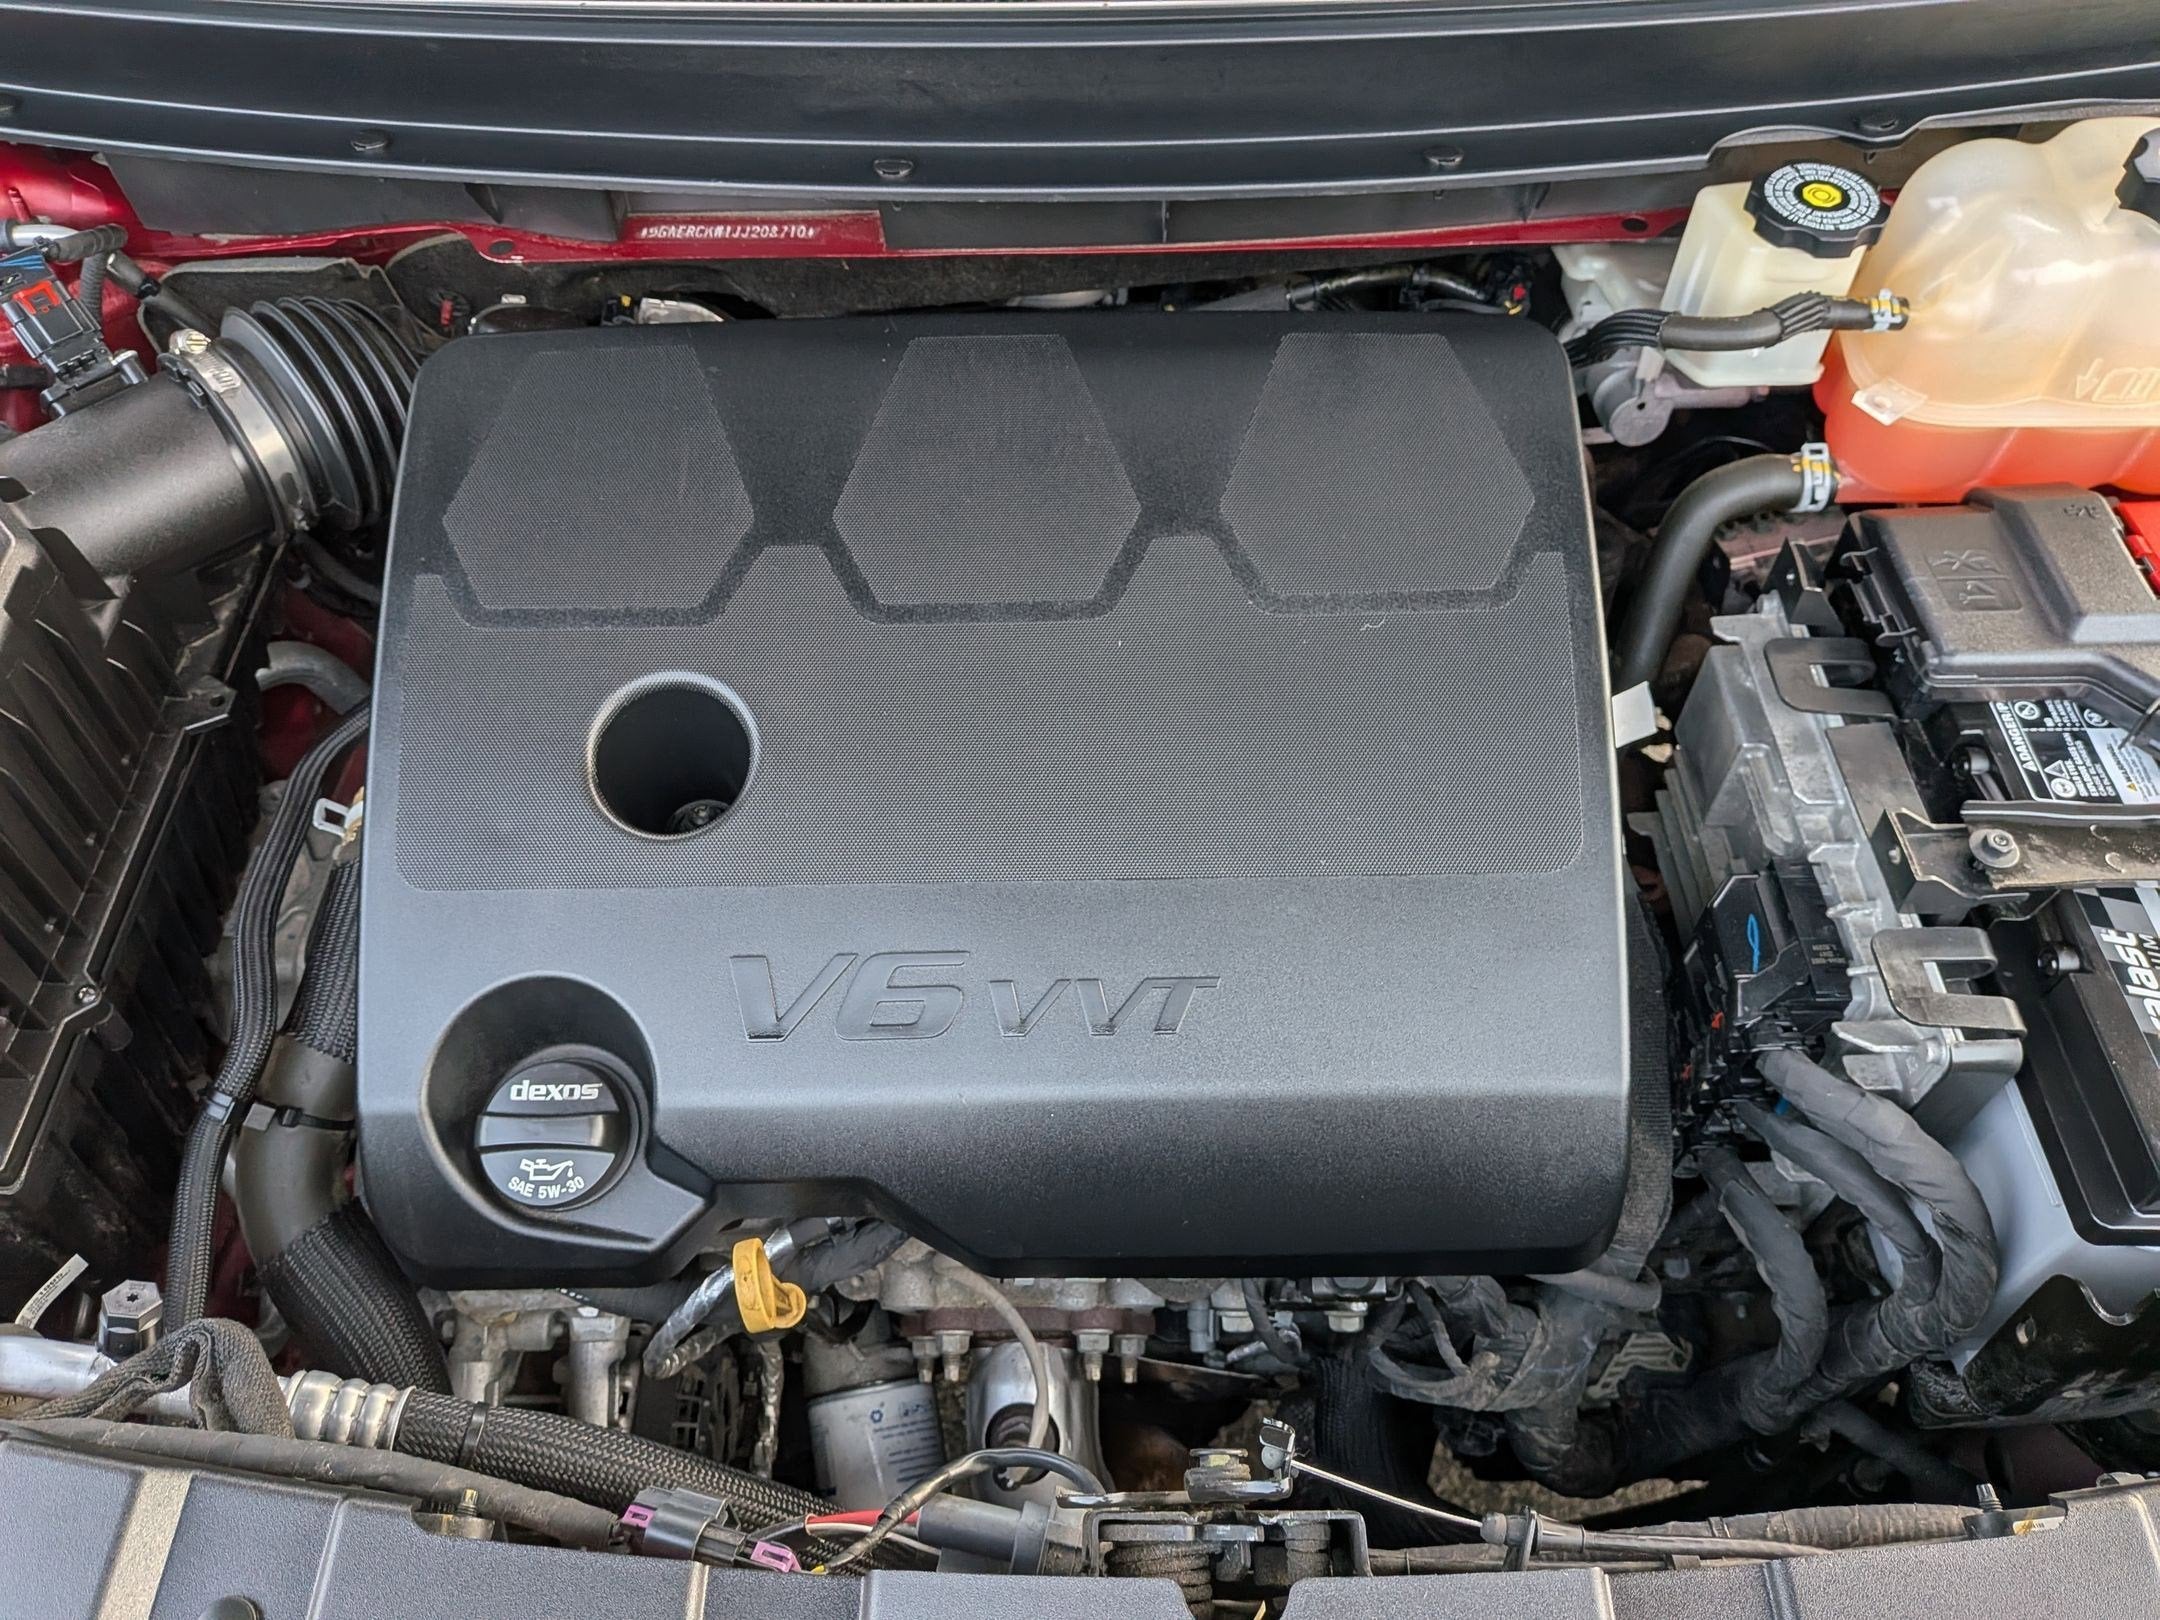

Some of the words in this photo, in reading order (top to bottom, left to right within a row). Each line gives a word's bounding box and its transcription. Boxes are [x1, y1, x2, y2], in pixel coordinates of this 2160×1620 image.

[1996, 702, 2032, 761] DANGER/P
[2062, 733, 2074, 746] CAN
[729, 950, 971, 1043] V6
[988, 975, 1221, 1038] VVT
[510, 1080, 602, 1101] dexos
[508, 1176, 535, 1198] SAE
[538, 1176, 585, 1199] 5W-30
